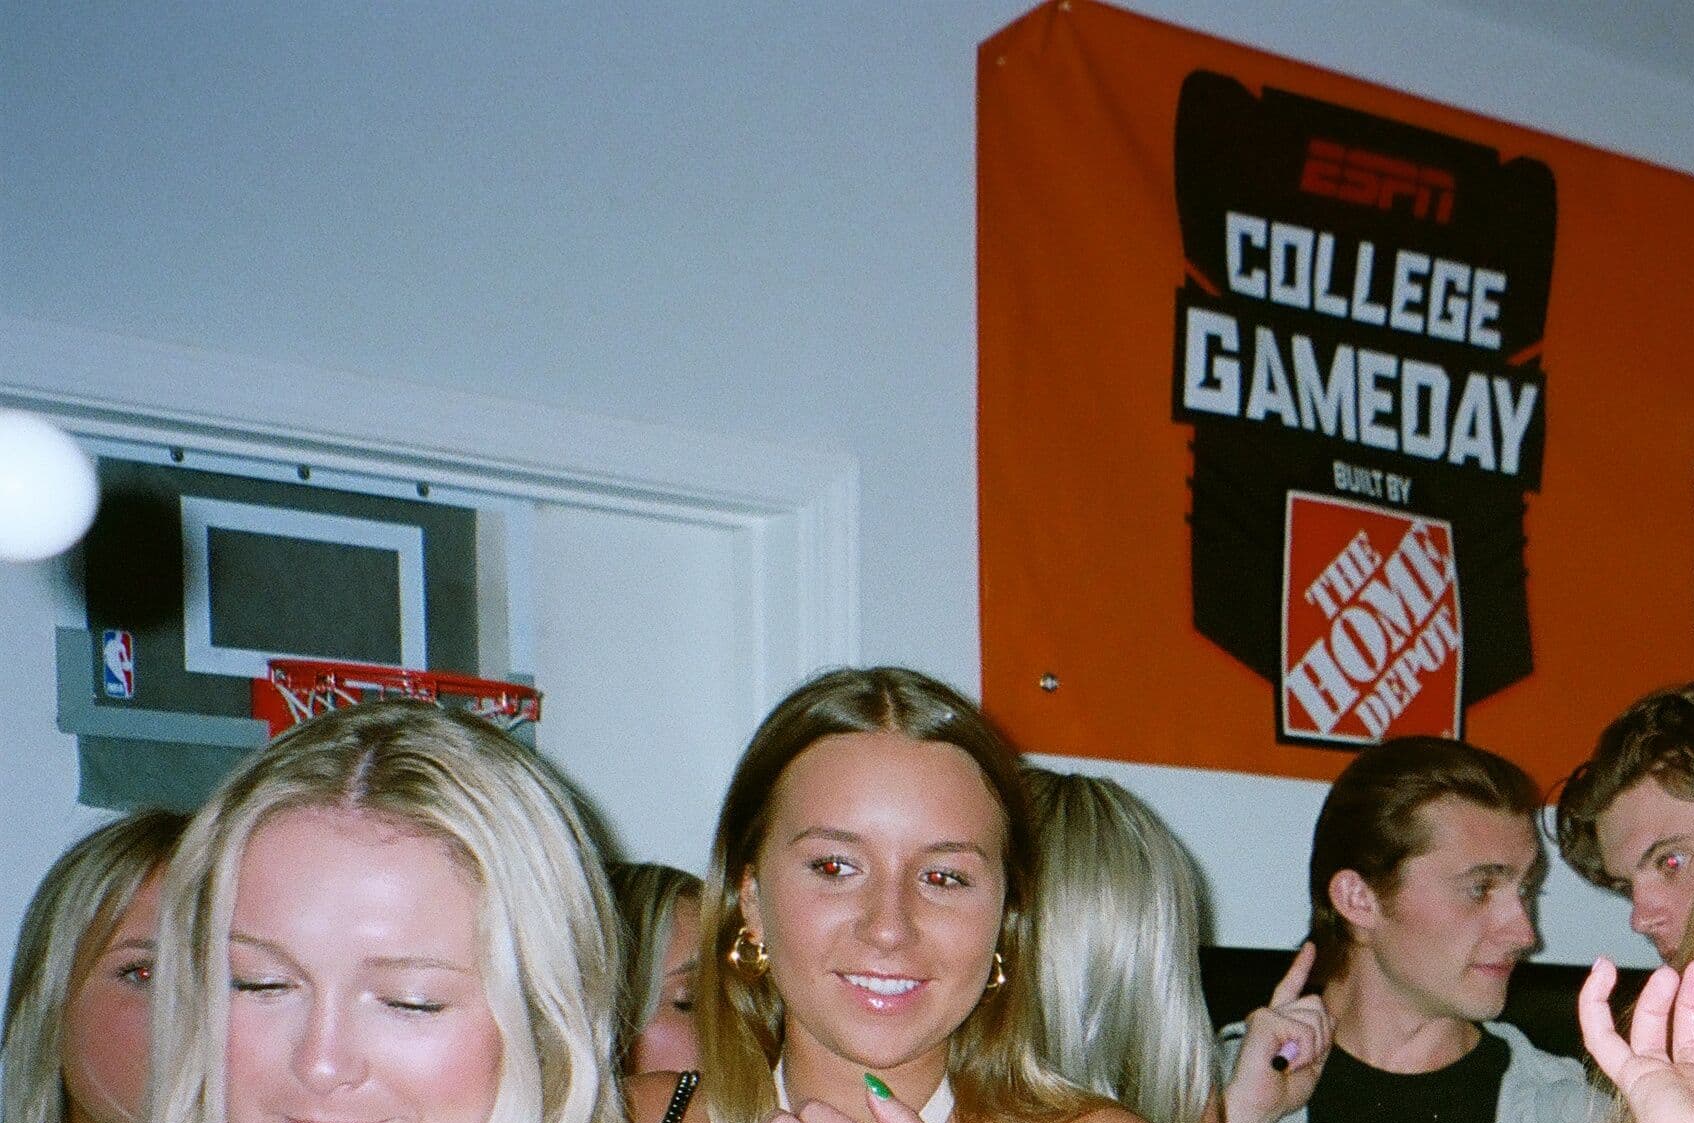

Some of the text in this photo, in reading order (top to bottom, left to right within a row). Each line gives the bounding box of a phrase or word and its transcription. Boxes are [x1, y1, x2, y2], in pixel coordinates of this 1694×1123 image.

[1301, 138, 1454, 224] ESPN
[1225, 210, 1507, 350] COLLEGE
[1184, 307, 1537, 475] GAMEDAY
[1333, 460, 1411, 505] BUILT BY
[1285, 519, 1456, 735] HOME
[1305, 530, 1383, 619] THE
[1355, 606, 1460, 741] DEPOT
